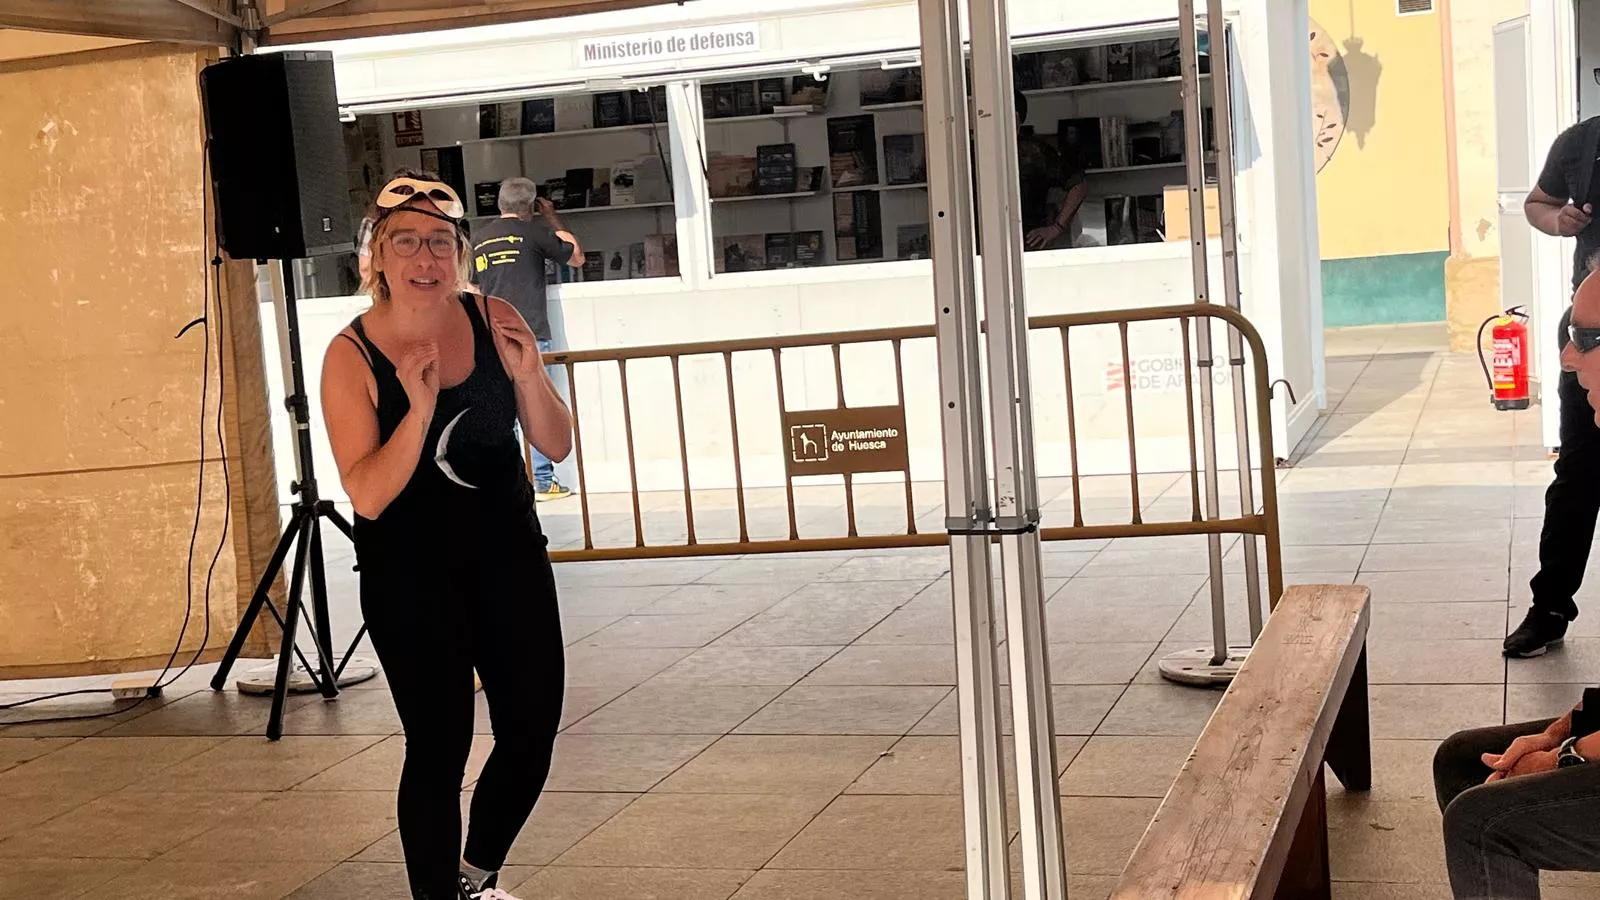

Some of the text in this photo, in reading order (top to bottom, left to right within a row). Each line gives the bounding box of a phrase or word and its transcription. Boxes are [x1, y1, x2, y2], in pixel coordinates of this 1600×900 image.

[583, 31, 755, 61] Ministerio de defensa
[1138, 374, 1161, 390] DE
[831, 428, 898, 442] Ayuntamiento
[831, 440, 887, 452] de Huesca
